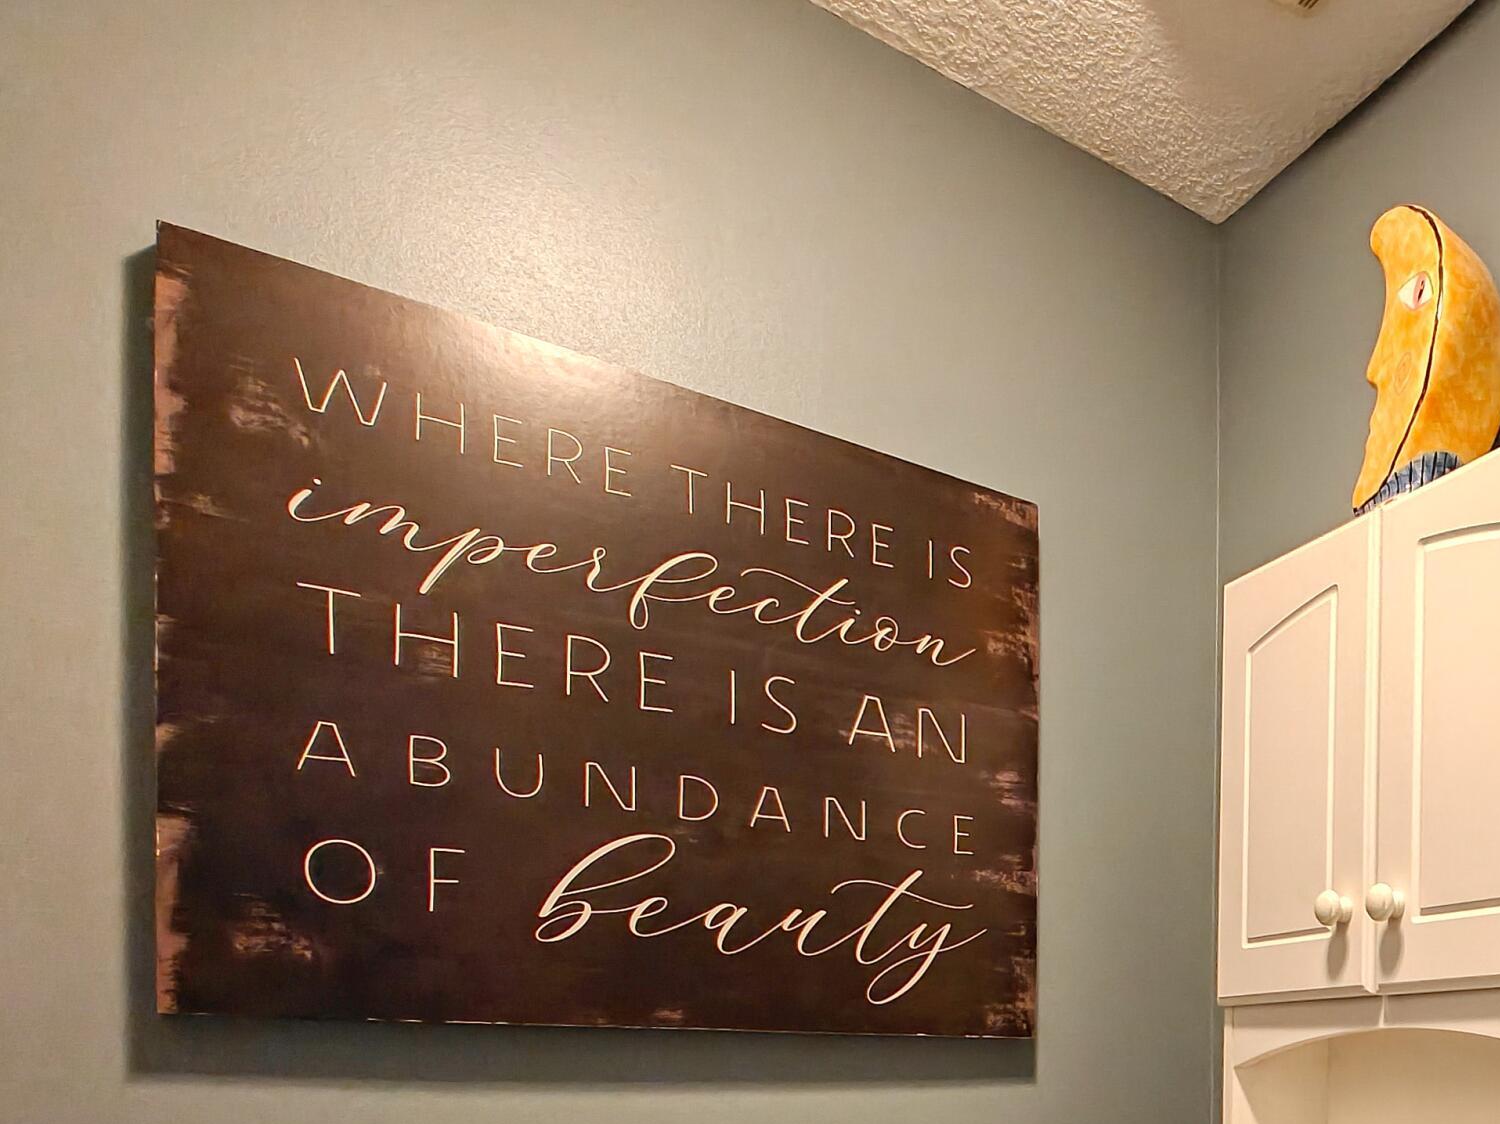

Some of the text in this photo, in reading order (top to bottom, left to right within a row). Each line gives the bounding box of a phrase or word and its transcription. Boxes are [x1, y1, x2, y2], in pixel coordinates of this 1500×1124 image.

[292, 356, 974, 589] WHERE THERE IS
[286, 477, 978, 667] imperfection
[296, 581, 967, 765] THERE IS AN
[295, 719, 976, 856] ABUNDANCE
[303, 832, 989, 1006] OF beauty
